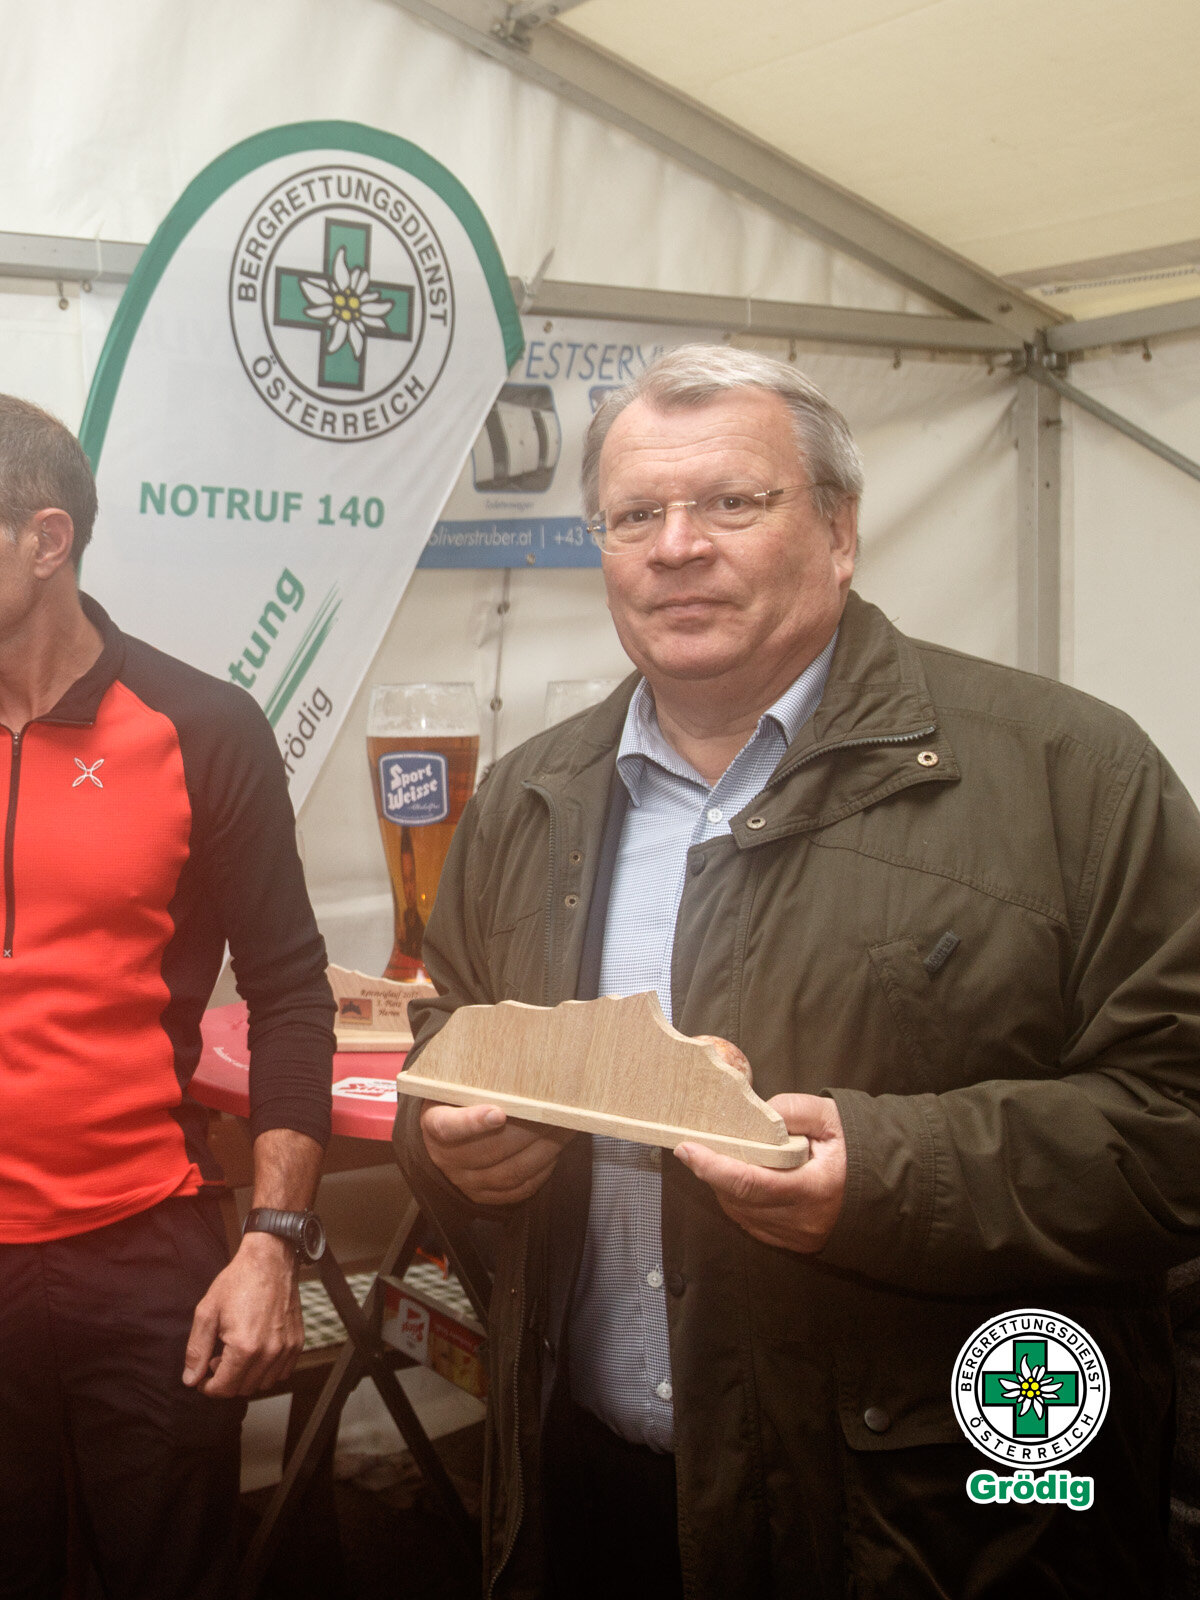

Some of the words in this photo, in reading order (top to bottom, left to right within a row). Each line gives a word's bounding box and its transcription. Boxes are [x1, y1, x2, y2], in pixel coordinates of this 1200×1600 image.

[237, 175, 448, 328] BERGRETTUNGSDIENST
[516, 341, 662, 381] ESTSERV
[252, 354, 426, 435] ÖSTERREICH
[140, 481, 303, 524] NOTRUF
[318, 493, 385, 529] 140
[227, 566, 306, 690] tung
[283, 686, 334, 783] rödig
[387, 779, 439, 811] Weisse
[389, 763, 433, 791] Sport
